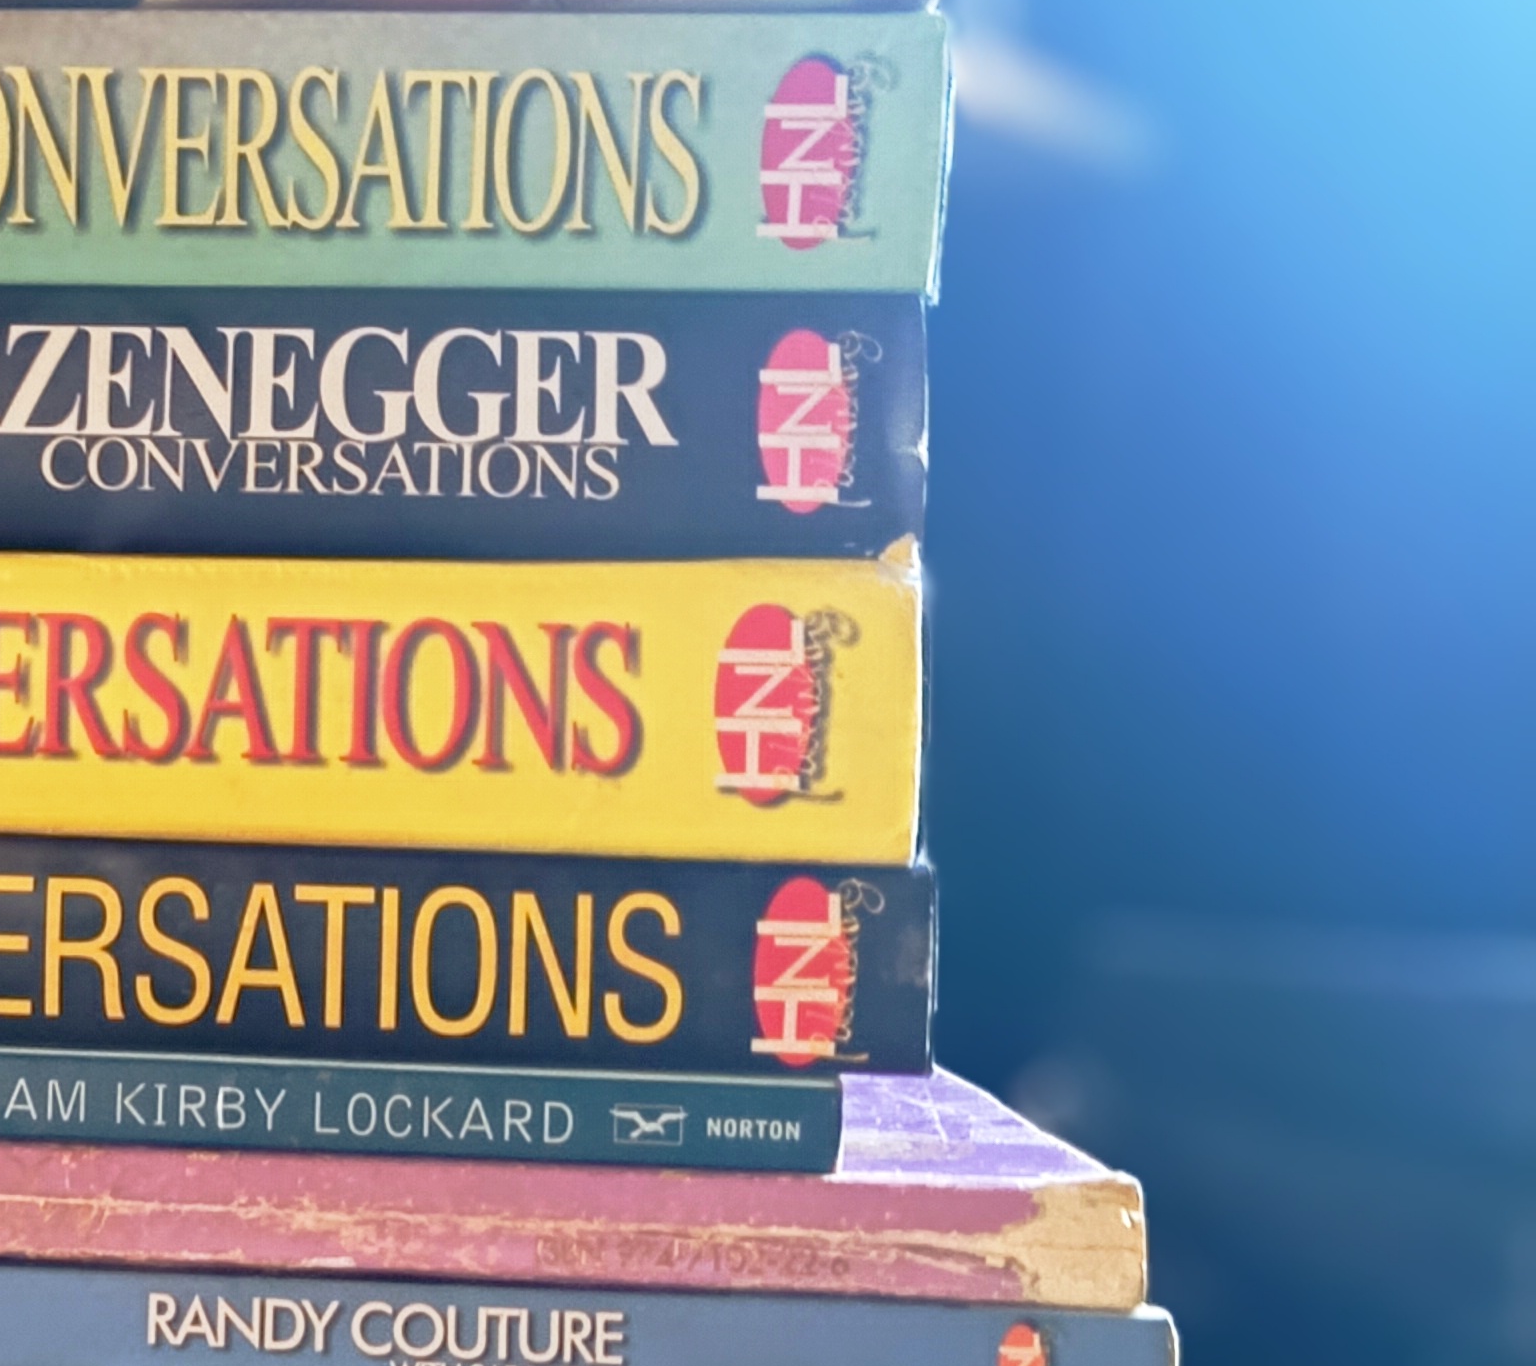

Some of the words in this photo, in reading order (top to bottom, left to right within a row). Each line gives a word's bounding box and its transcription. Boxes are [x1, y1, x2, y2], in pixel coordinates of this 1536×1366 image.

[41, 435, 621, 501] CONVERSATIONS
[115, 1080, 288, 1132] KIRBY
[313, 1089, 575, 1146] LOCKARD
[706, 1116, 802, 1142] NORTON
[146, 1292, 340, 1356] RANDY
[350, 1300, 626, 1366] COUTURE
